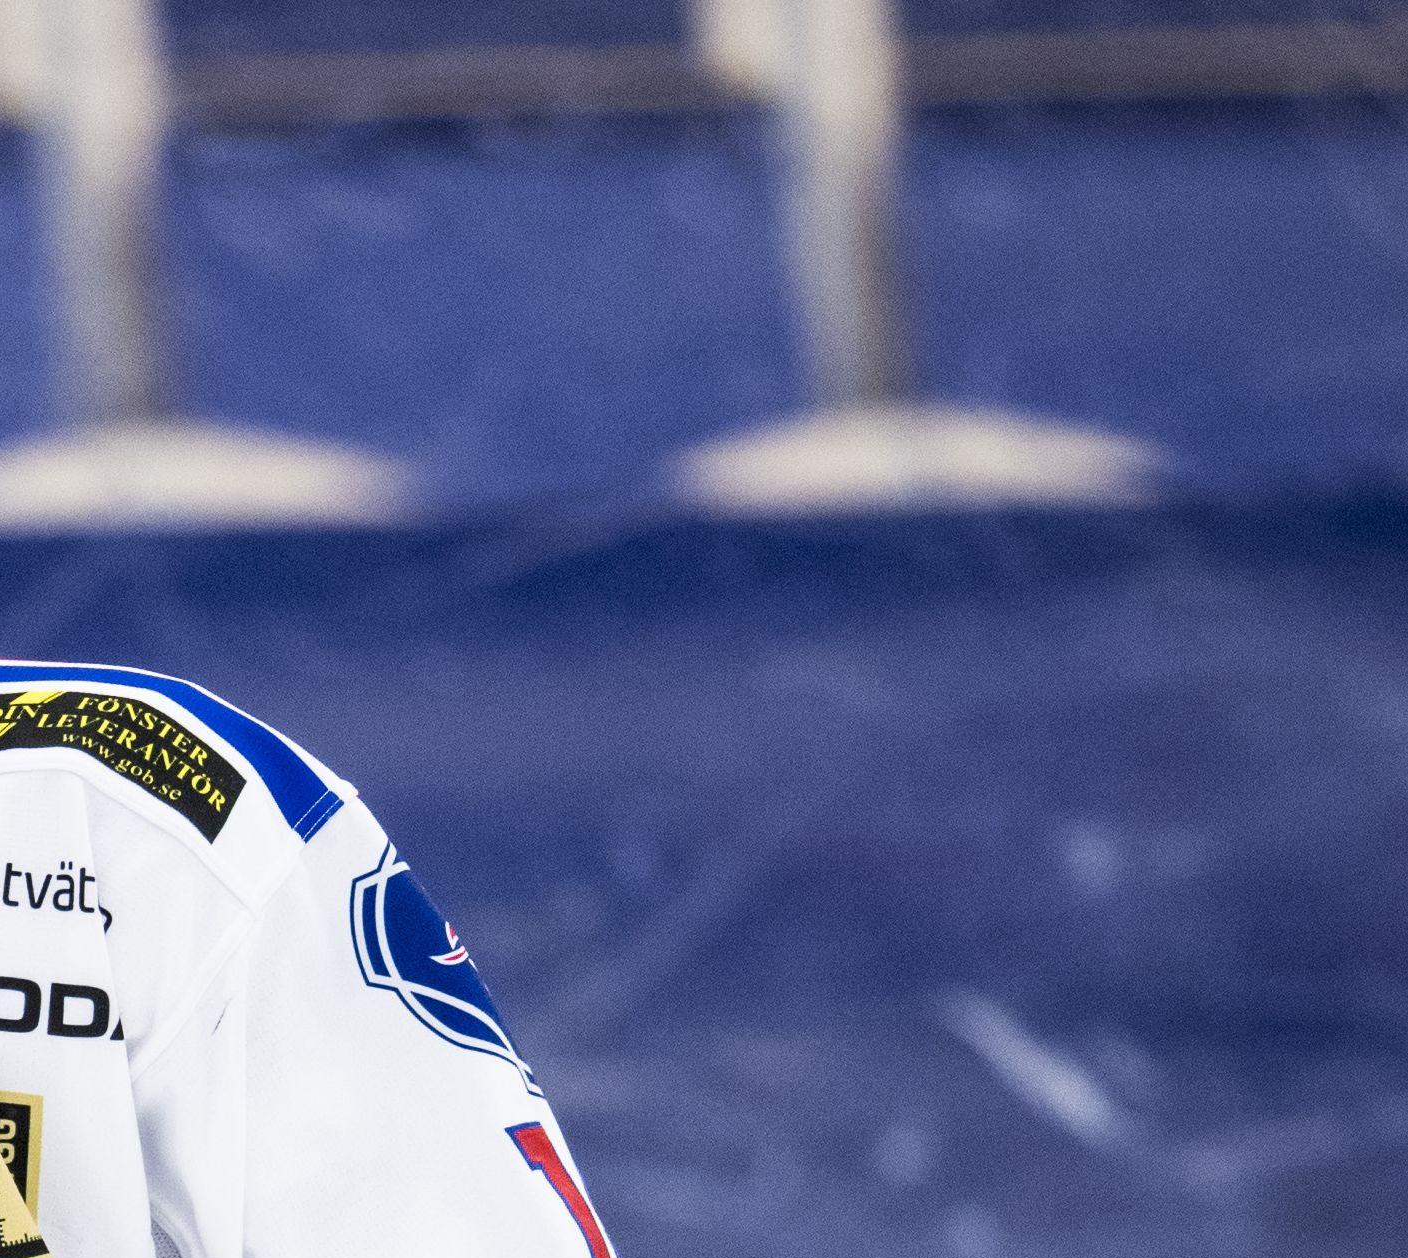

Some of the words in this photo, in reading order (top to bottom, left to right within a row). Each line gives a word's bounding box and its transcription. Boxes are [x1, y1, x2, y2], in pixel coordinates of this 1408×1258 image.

[37, 706, 227, 813] LEVERANTÖR
[62, 732, 183, 801] www.gob.se
[78, 697, 209, 767] FÖNSTER
